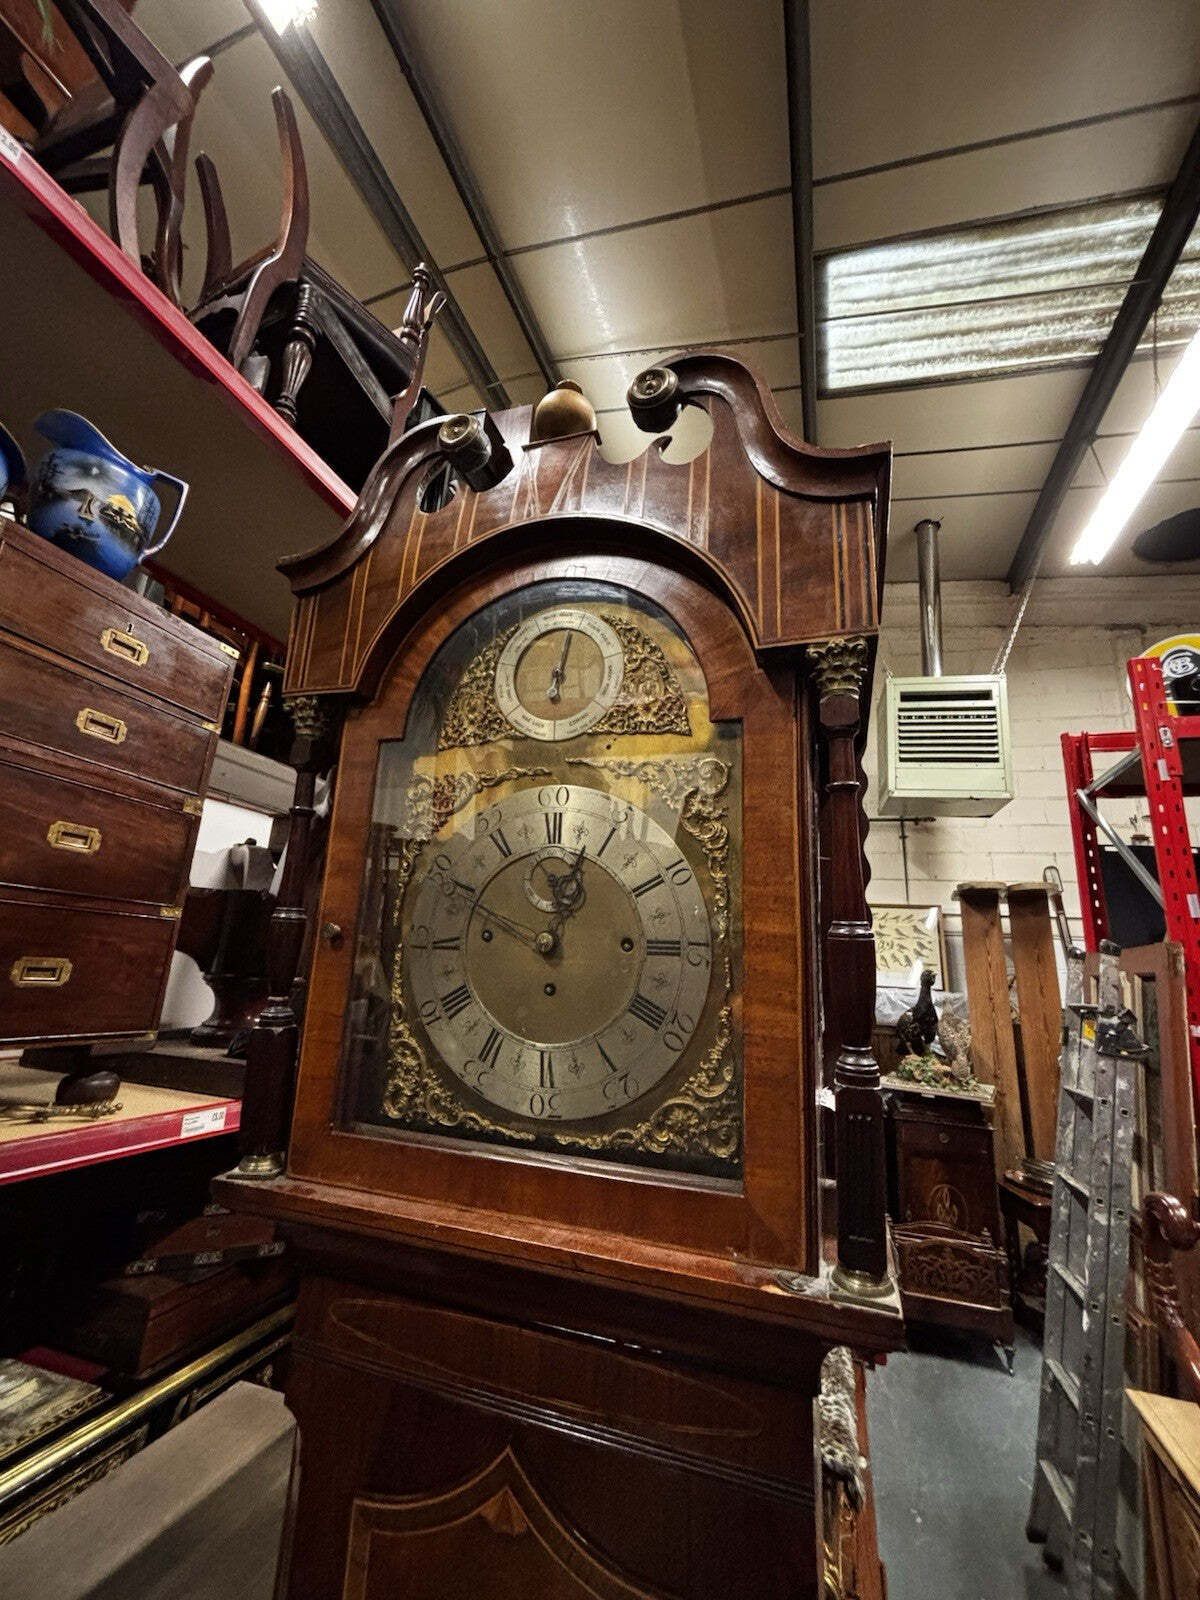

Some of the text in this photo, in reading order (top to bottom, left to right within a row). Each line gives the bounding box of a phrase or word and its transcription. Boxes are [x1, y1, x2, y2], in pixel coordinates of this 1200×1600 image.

[665, 858, 693, 886] 10
[631, 873, 665, 900] II
[646, 939, 681, 957] III
[687, 941, 710, 969] 15
